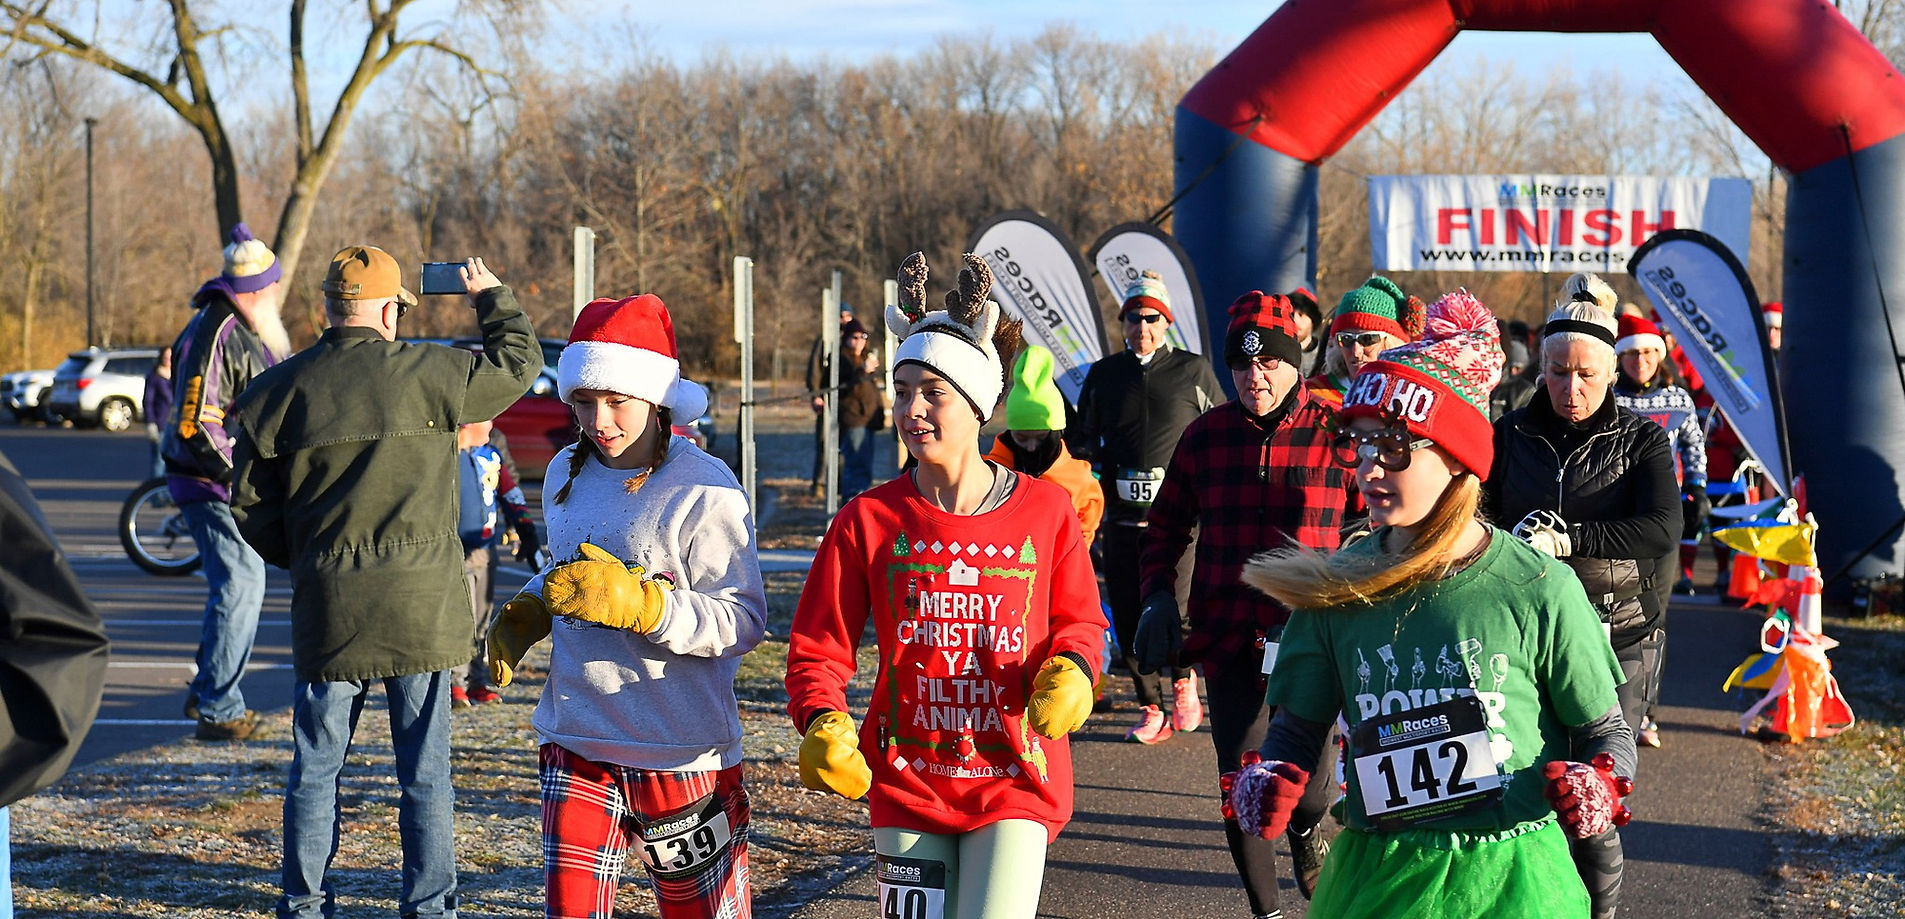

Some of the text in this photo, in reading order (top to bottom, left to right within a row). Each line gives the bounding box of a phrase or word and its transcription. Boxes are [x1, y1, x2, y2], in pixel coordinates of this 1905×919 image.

[1499, 184, 1606, 198] MMRaces
[1437, 208, 1676, 248] FINISH
[1421, 249, 1624, 263] www.mmraces
[1343, 372, 1435, 423] HO HO
[1130, 481, 1152, 501] 95
[920, 590, 1003, 621] MERRY
[897, 620, 1023, 653] CHRISTMAS
[941, 650, 982, 676] YA
[912, 703, 1003, 732] ANIMA
[1378, 714, 1449, 738] MMRaces
[929, 763, 957, 778] HOME
[1378, 740, 1477, 808] 142
[643, 812, 699, 836] MMRaces
[644, 825, 717, 871] 139
